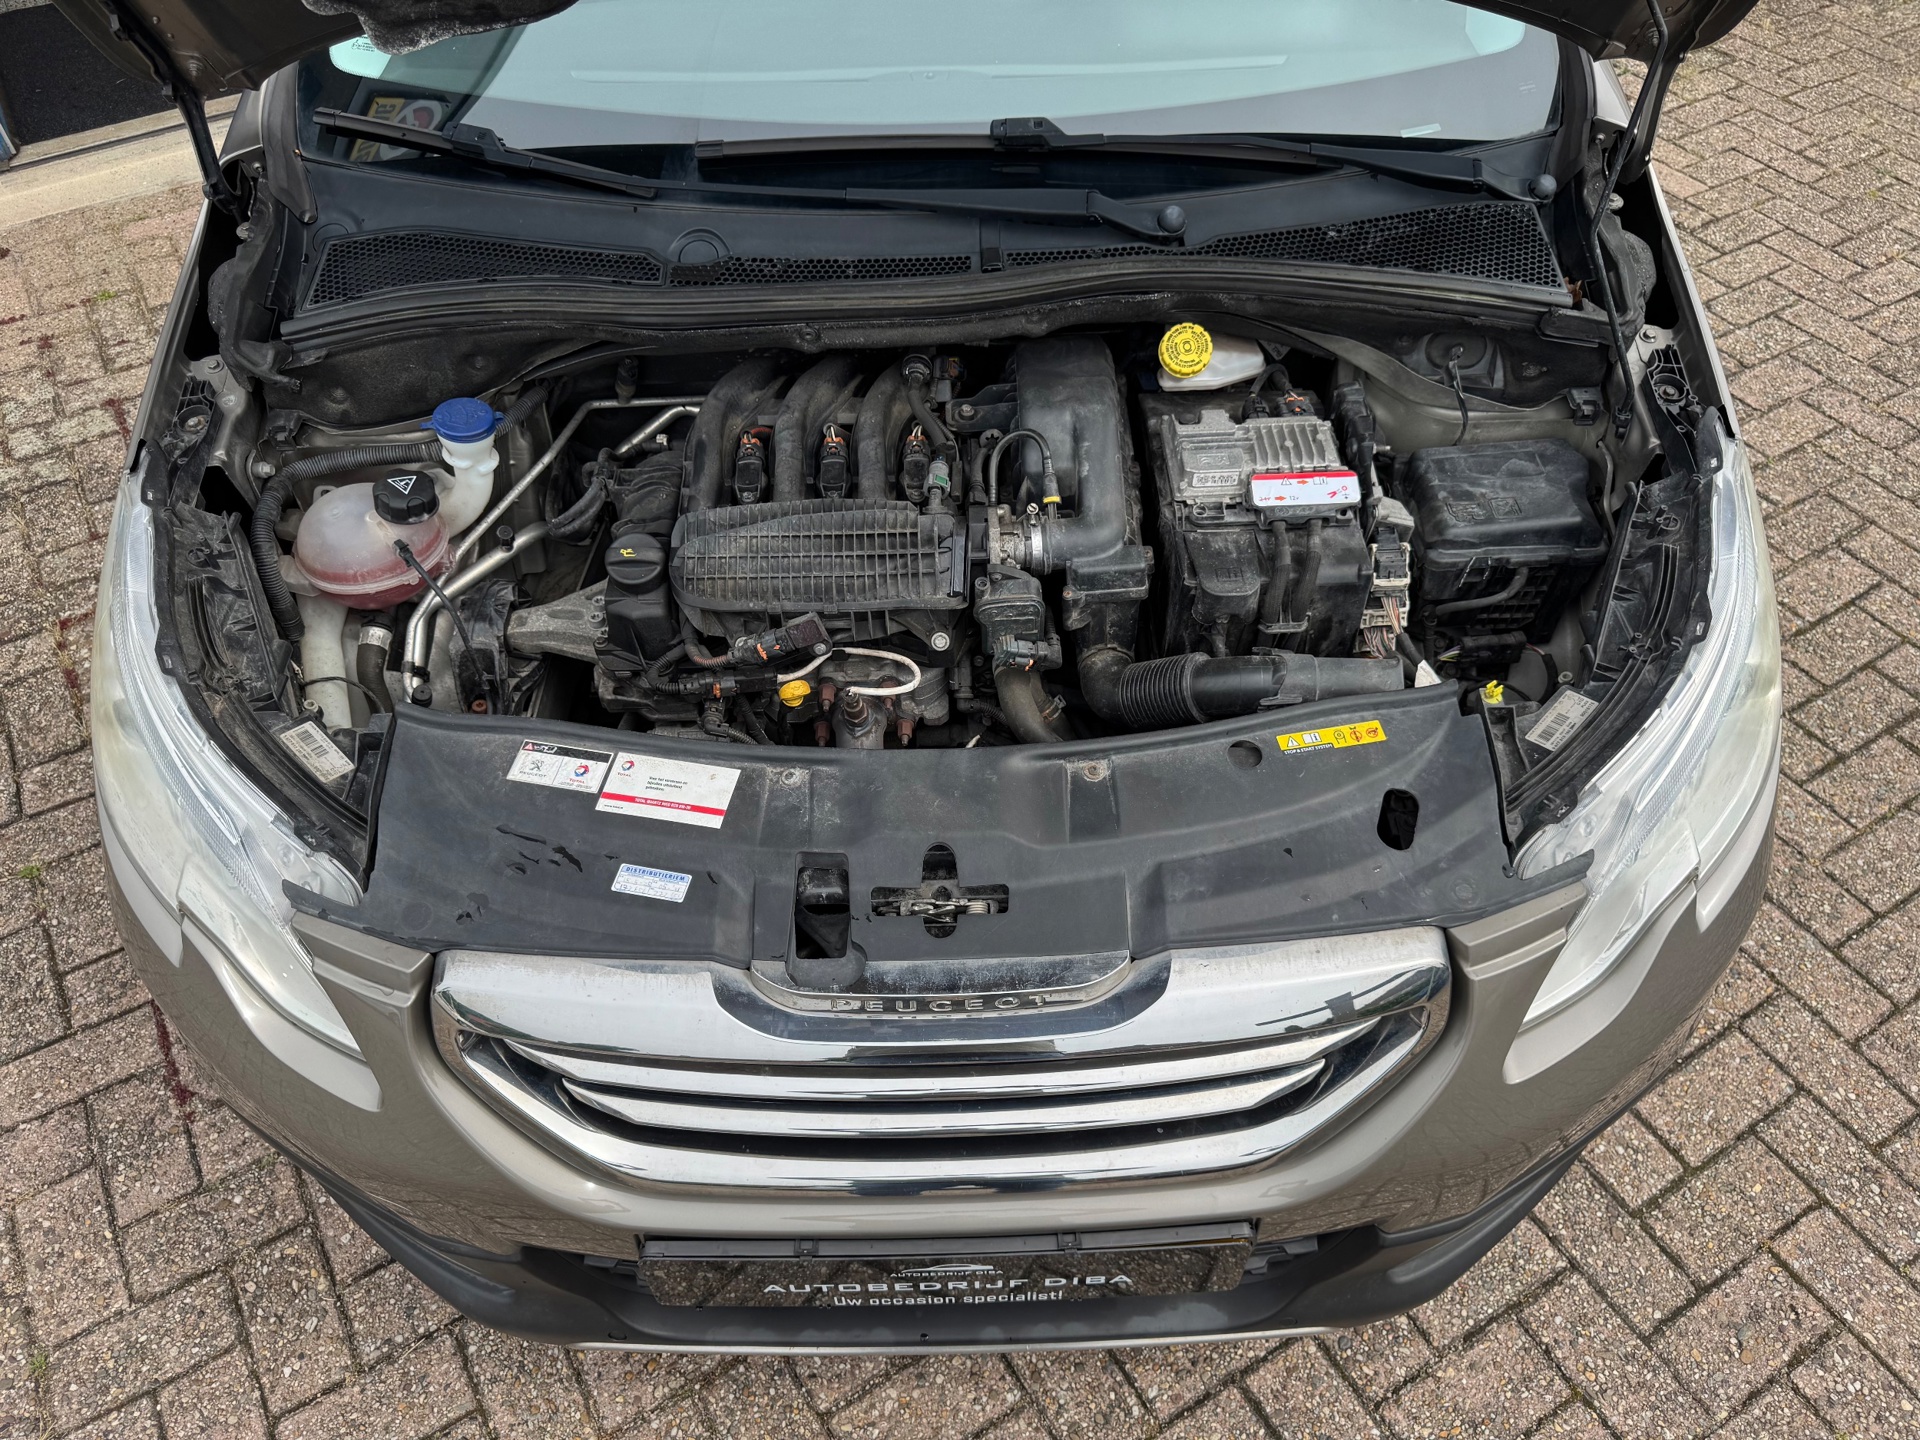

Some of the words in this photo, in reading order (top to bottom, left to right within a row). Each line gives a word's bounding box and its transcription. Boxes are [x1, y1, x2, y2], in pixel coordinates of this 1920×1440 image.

[519, 770, 547, 778] PEUGEOT
[625, 866, 685, 881] DISTRIBUTIERIEM
[830, 992, 1052, 1012] PEUGEOT
[889, 1270, 973, 1278] AUTOBEDRIJF
[762, 1278, 1029, 1294] AUTOBEDRIJF
[1044, 1274, 1133, 1287] DIBA
[833, 1295, 863, 1306] Uw
[869, 1294, 956, 1306] occasion
[963, 1290, 1063, 1305] specialist!
